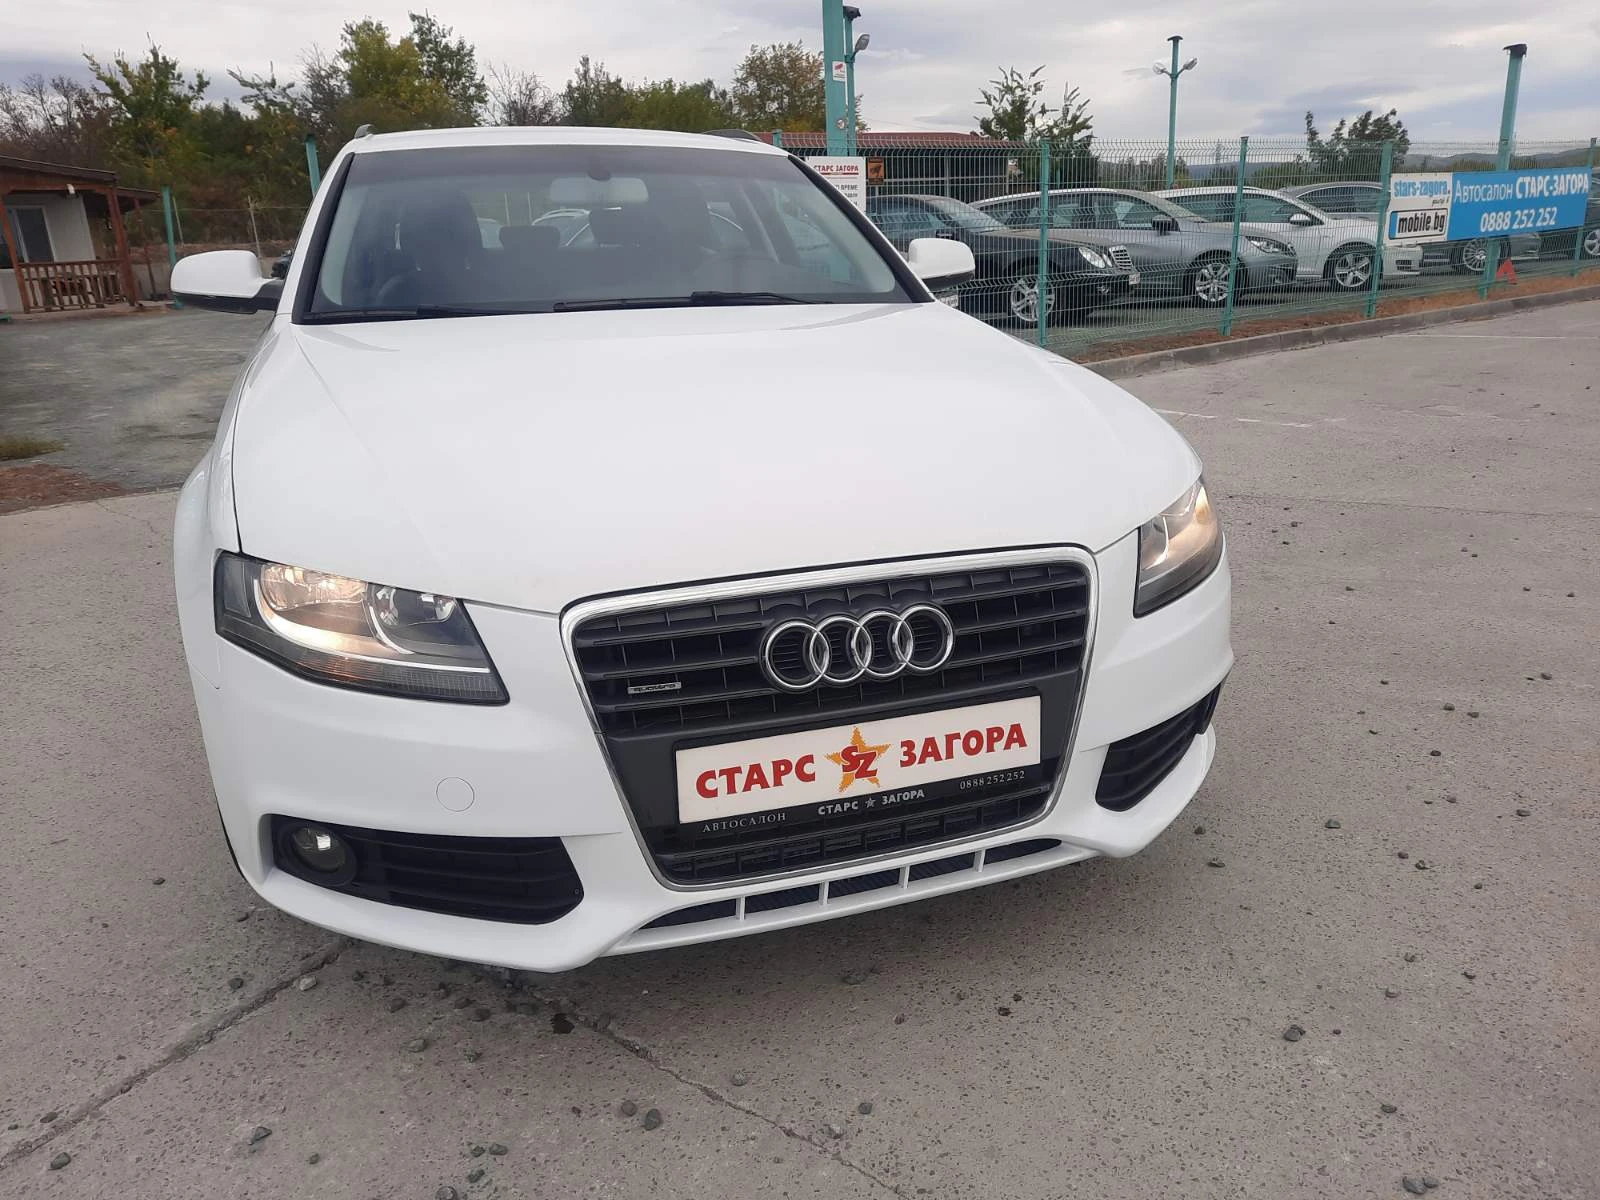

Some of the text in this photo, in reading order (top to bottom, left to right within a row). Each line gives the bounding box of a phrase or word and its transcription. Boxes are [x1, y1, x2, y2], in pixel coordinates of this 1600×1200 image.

[1454, 180, 1513, 203] Автосалон
[1398, 212, 1445, 233] mobile.bg
[1480, 206, 1557, 232] 0888 252 252
[695, 723, 1027, 799] СТАРС ЗАГОРА
[841, 745, 878, 779] SZ
[959, 770, 1025, 790] 0888 252 252
[817, 789, 925, 815] СТАРС ЗАГОРА
[702, 812, 787, 833] АВТОСАЛОН
